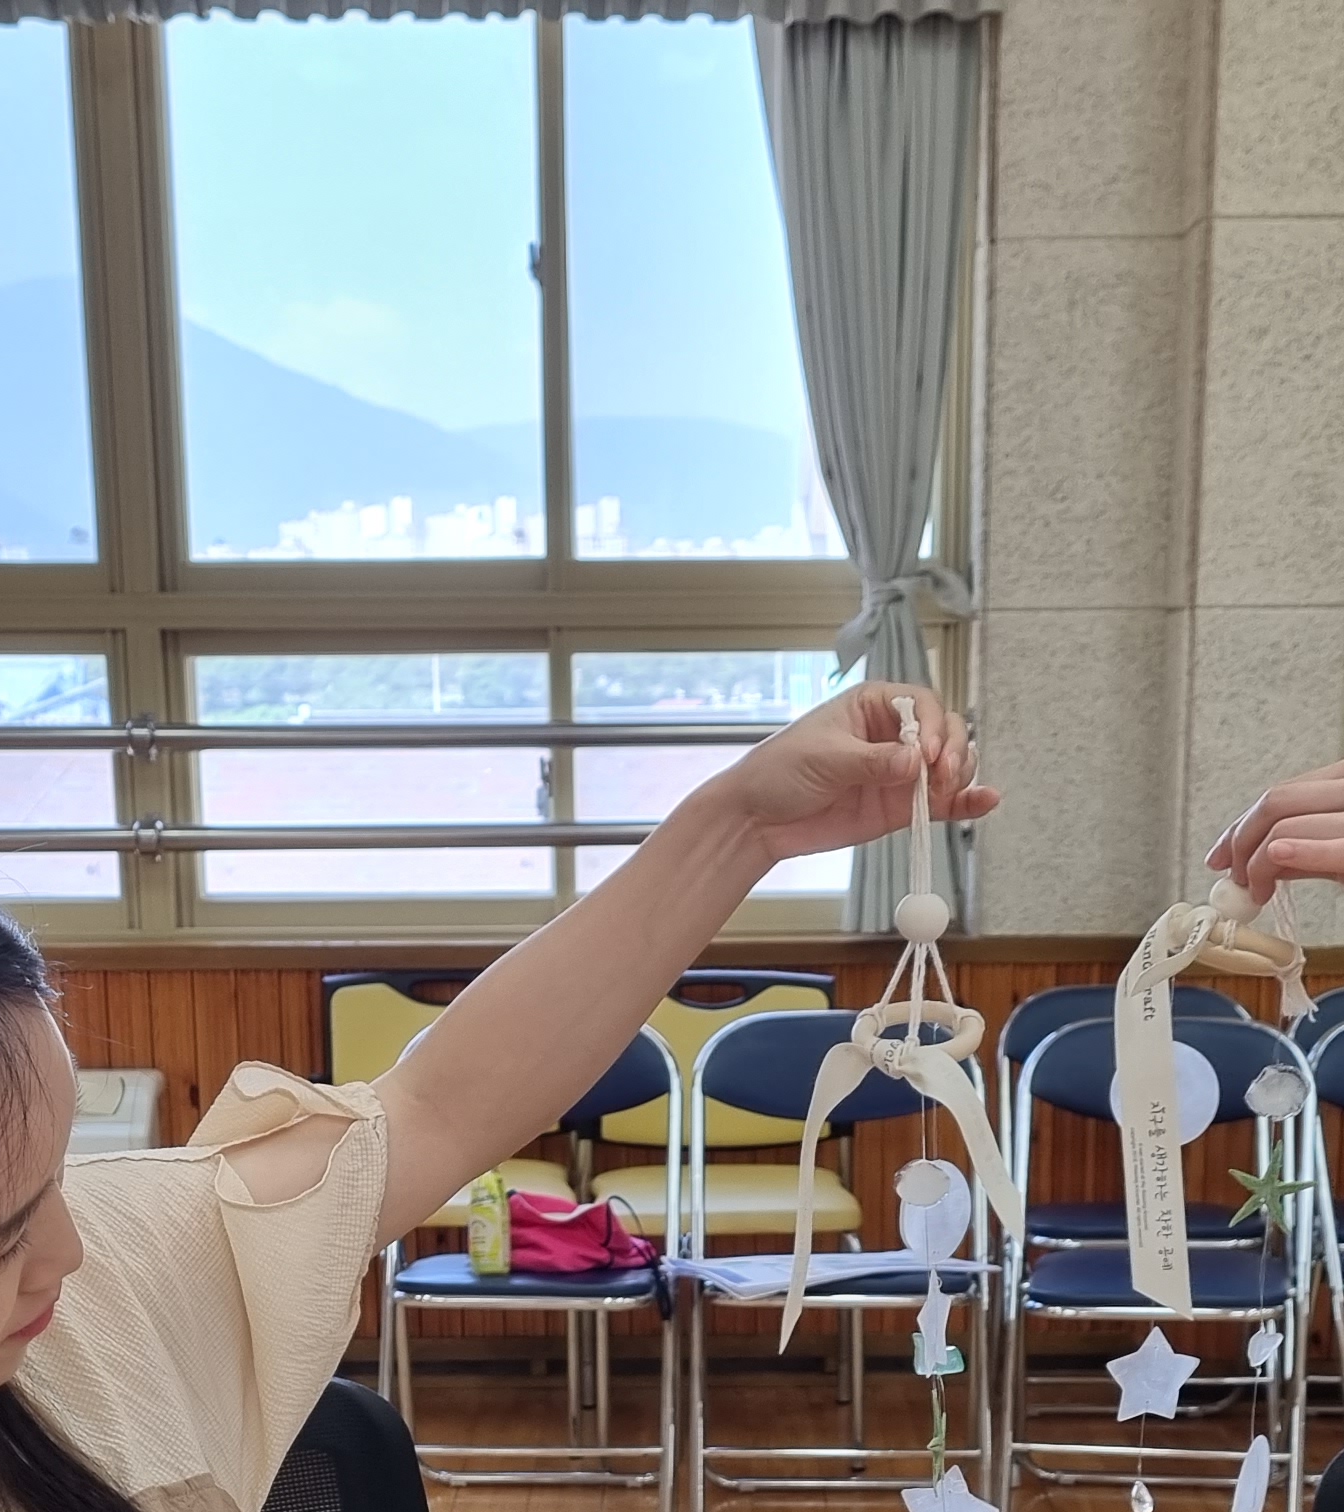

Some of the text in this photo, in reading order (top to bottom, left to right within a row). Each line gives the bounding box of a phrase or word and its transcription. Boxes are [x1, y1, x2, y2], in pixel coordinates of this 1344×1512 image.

[1150, 1145, 1169, 1201] 생각하는
[1156, 1208, 1173, 1239] 착한
[1158, 1246, 1174, 1271] 공예
